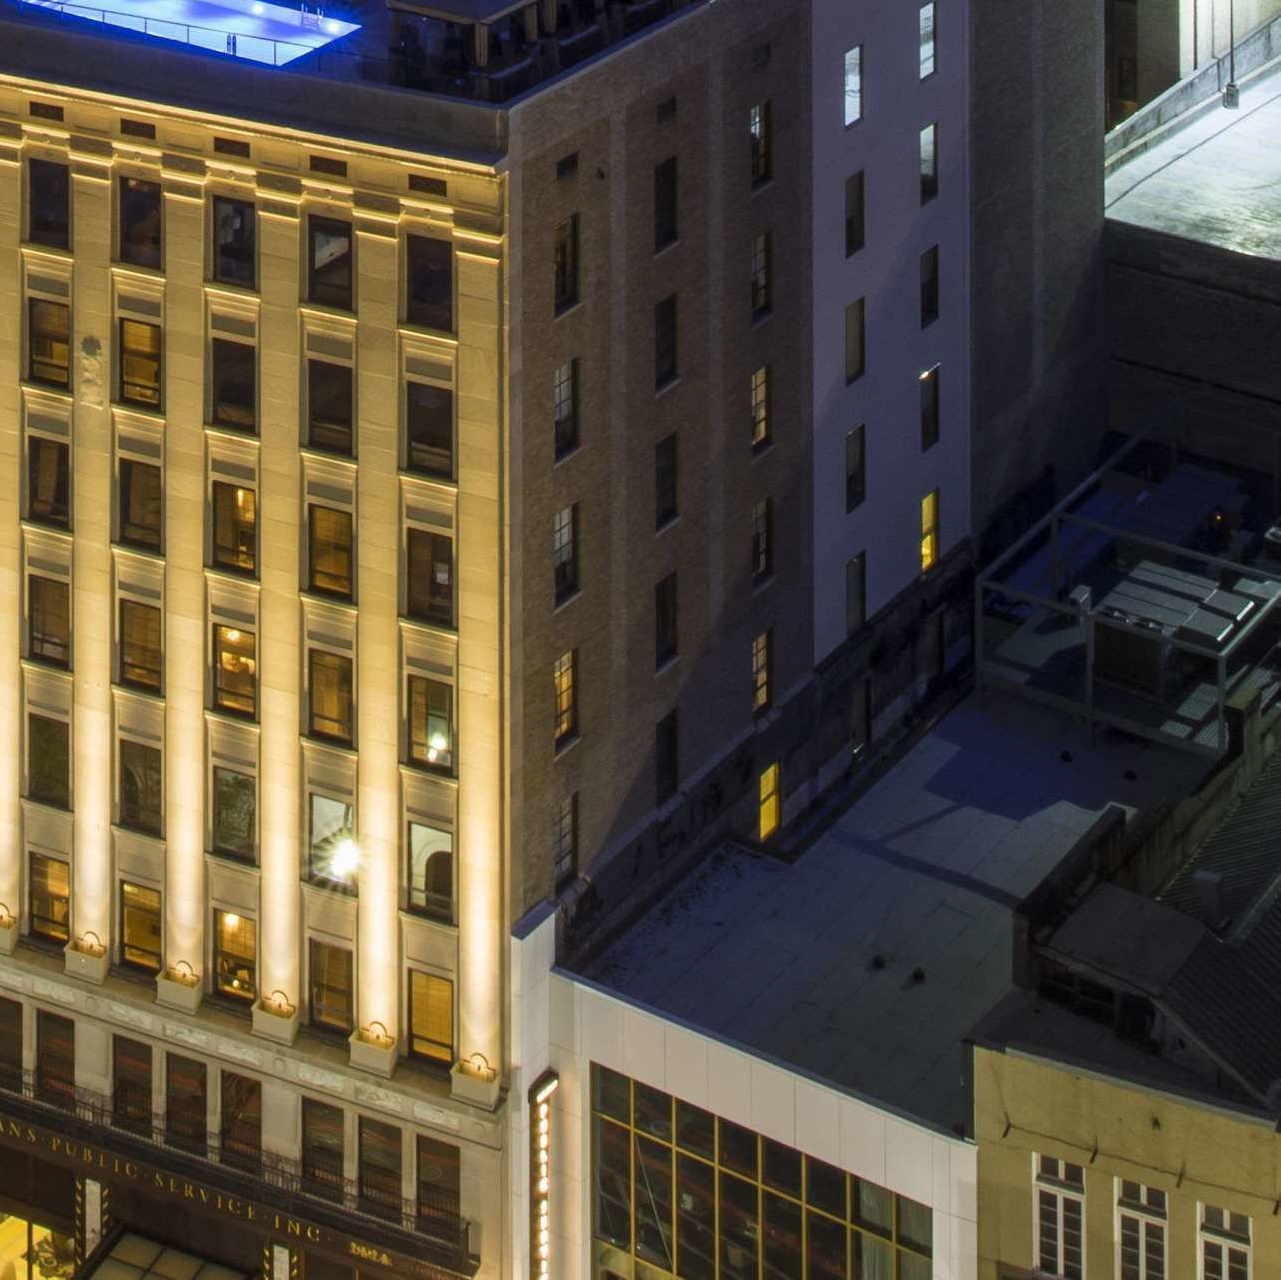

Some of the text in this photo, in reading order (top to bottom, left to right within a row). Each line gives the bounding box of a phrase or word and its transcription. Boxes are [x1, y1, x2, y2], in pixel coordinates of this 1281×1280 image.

[50, 1138, 138, 1179] PUBLIC
[154, 1172, 257, 1220] SERVICE
[272, 1214, 321, 1243] INC
